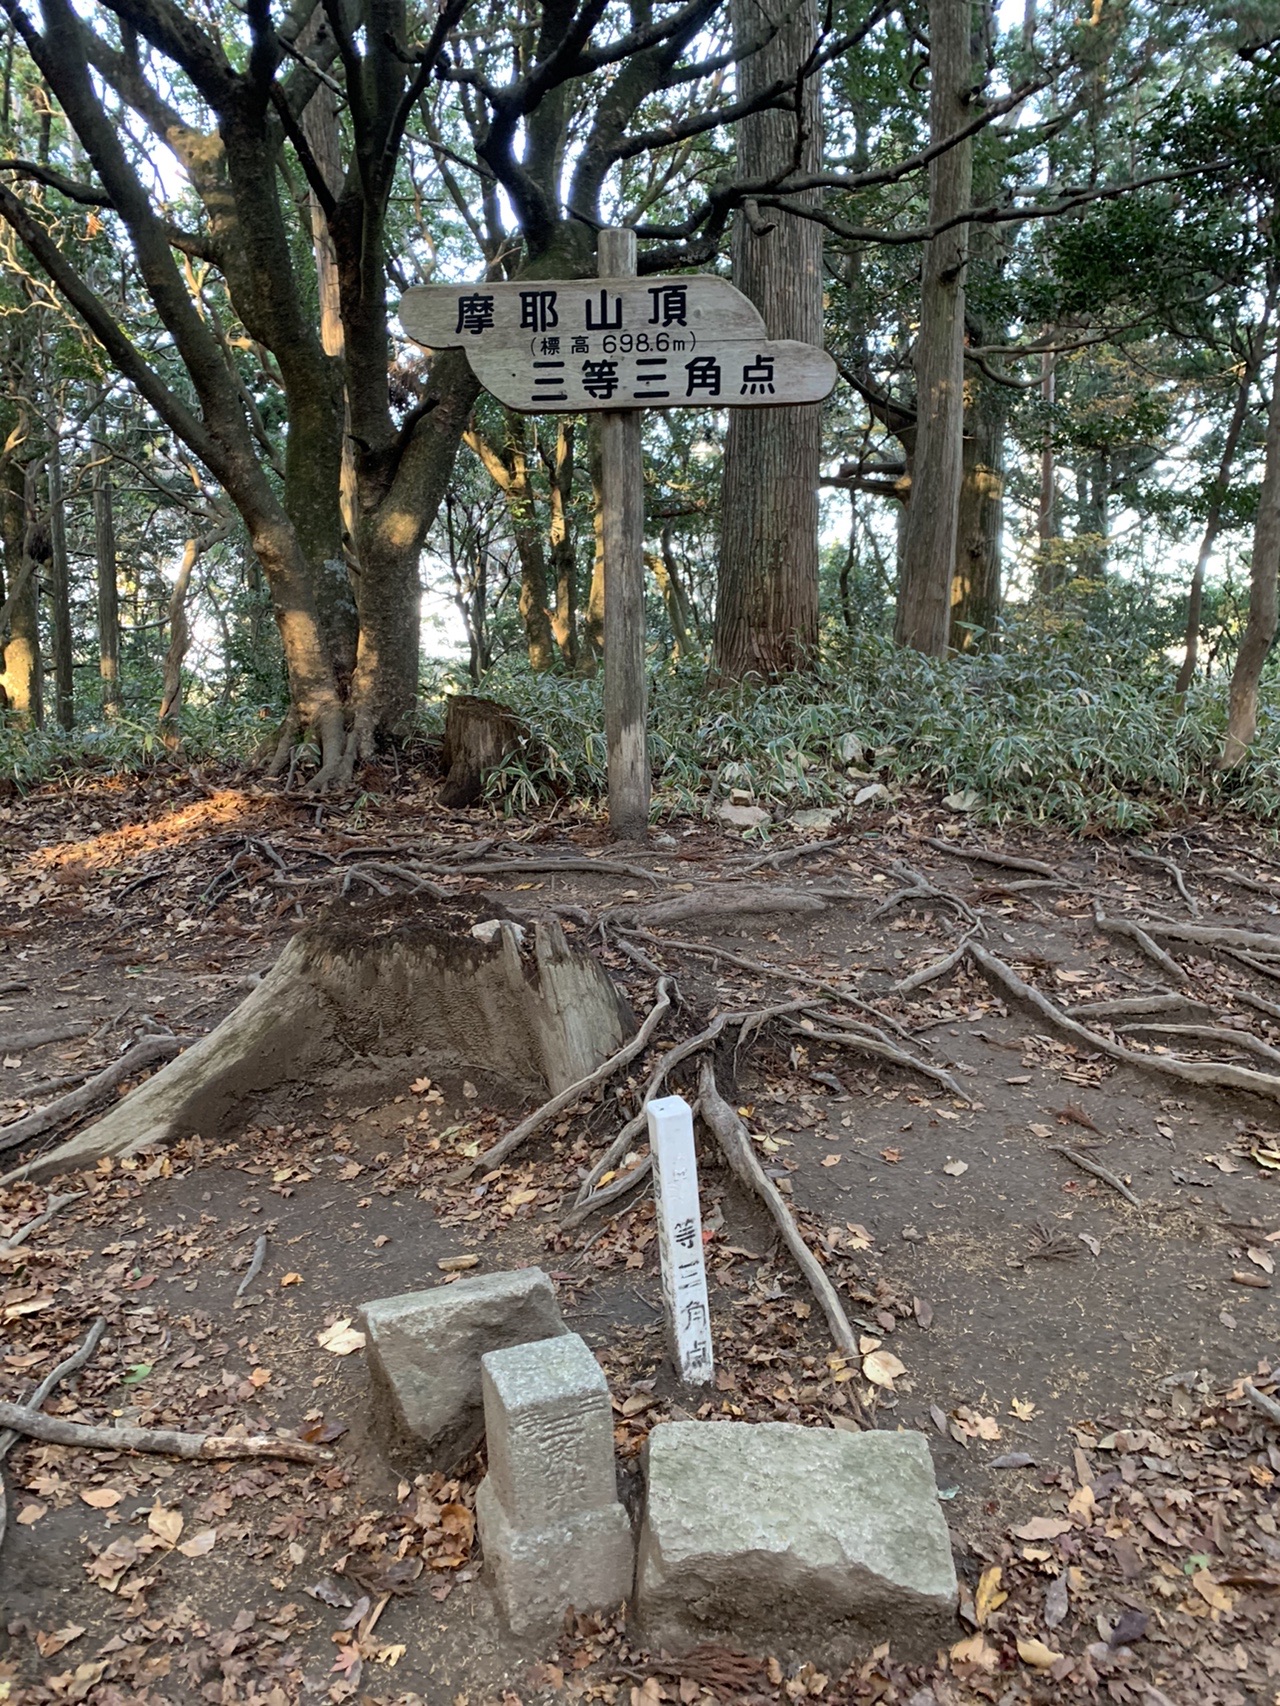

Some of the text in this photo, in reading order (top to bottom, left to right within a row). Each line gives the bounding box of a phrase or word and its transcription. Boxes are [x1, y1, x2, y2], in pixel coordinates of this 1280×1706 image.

[455, 284, 688, 335] 摩耶山頂
[531, 354, 776, 402] 三等三角点
